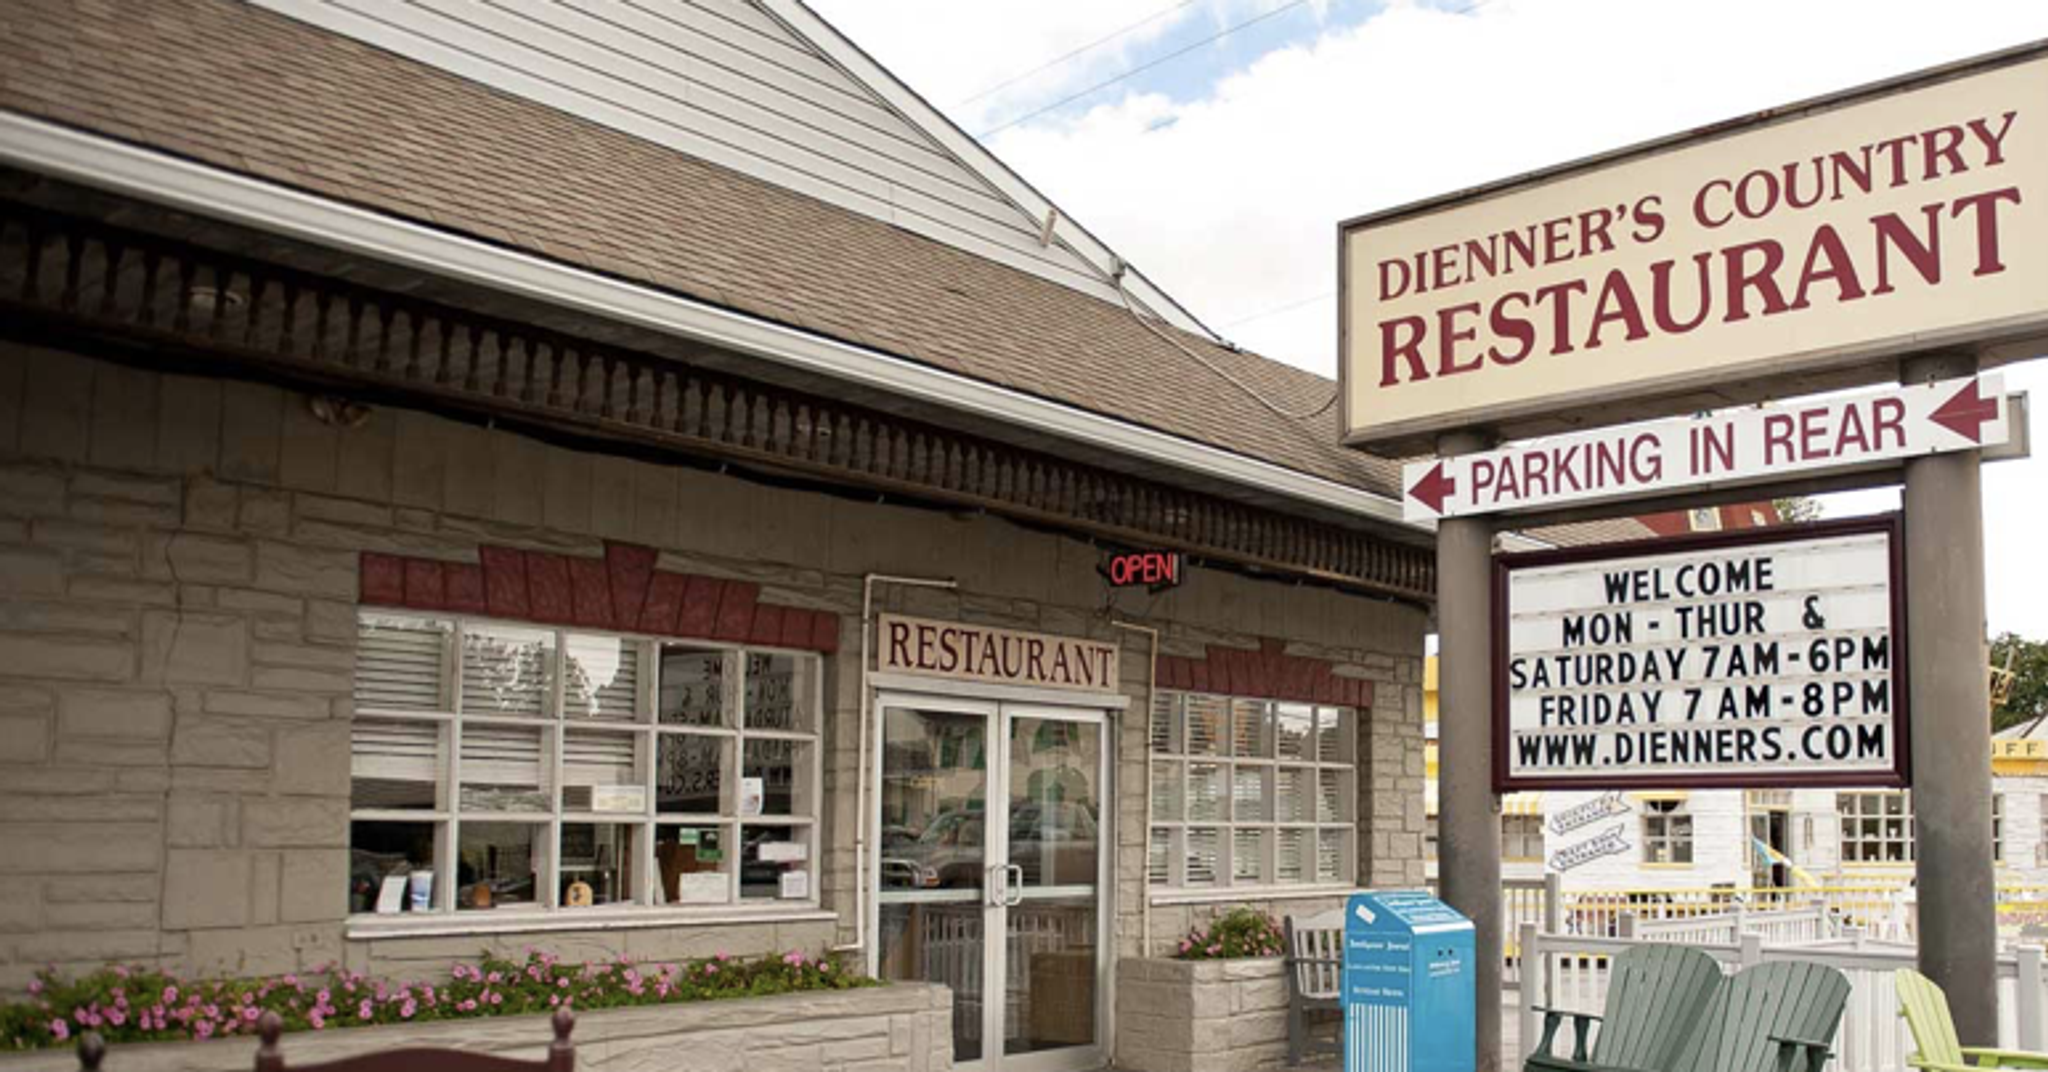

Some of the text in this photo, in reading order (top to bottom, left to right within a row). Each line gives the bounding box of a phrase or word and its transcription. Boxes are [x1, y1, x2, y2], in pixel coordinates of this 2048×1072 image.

[1377, 111, 2018, 301] DIENNER'S COUNTRY
[1378, 187, 2022, 388] RESTAURANT
[1470, 397, 1907, 506] PARKING IN REAR
[1111, 553, 1173, 585] OPEN
[1604, 558, 1774, 604] WELCOME
[1562, 612, 1633, 647] MON
[1675, 601, 1766, 639] THUR
[1802, 595, 1826, 630] &
[888, 621, 1113, 687] RESTAURANT
[1510, 635, 1889, 690] SATURDAY 7AM-6PM
[1540, 690, 1662, 727] FRIDAY
[1518, 724, 1885, 766] WWW.DIENNERS.COM
